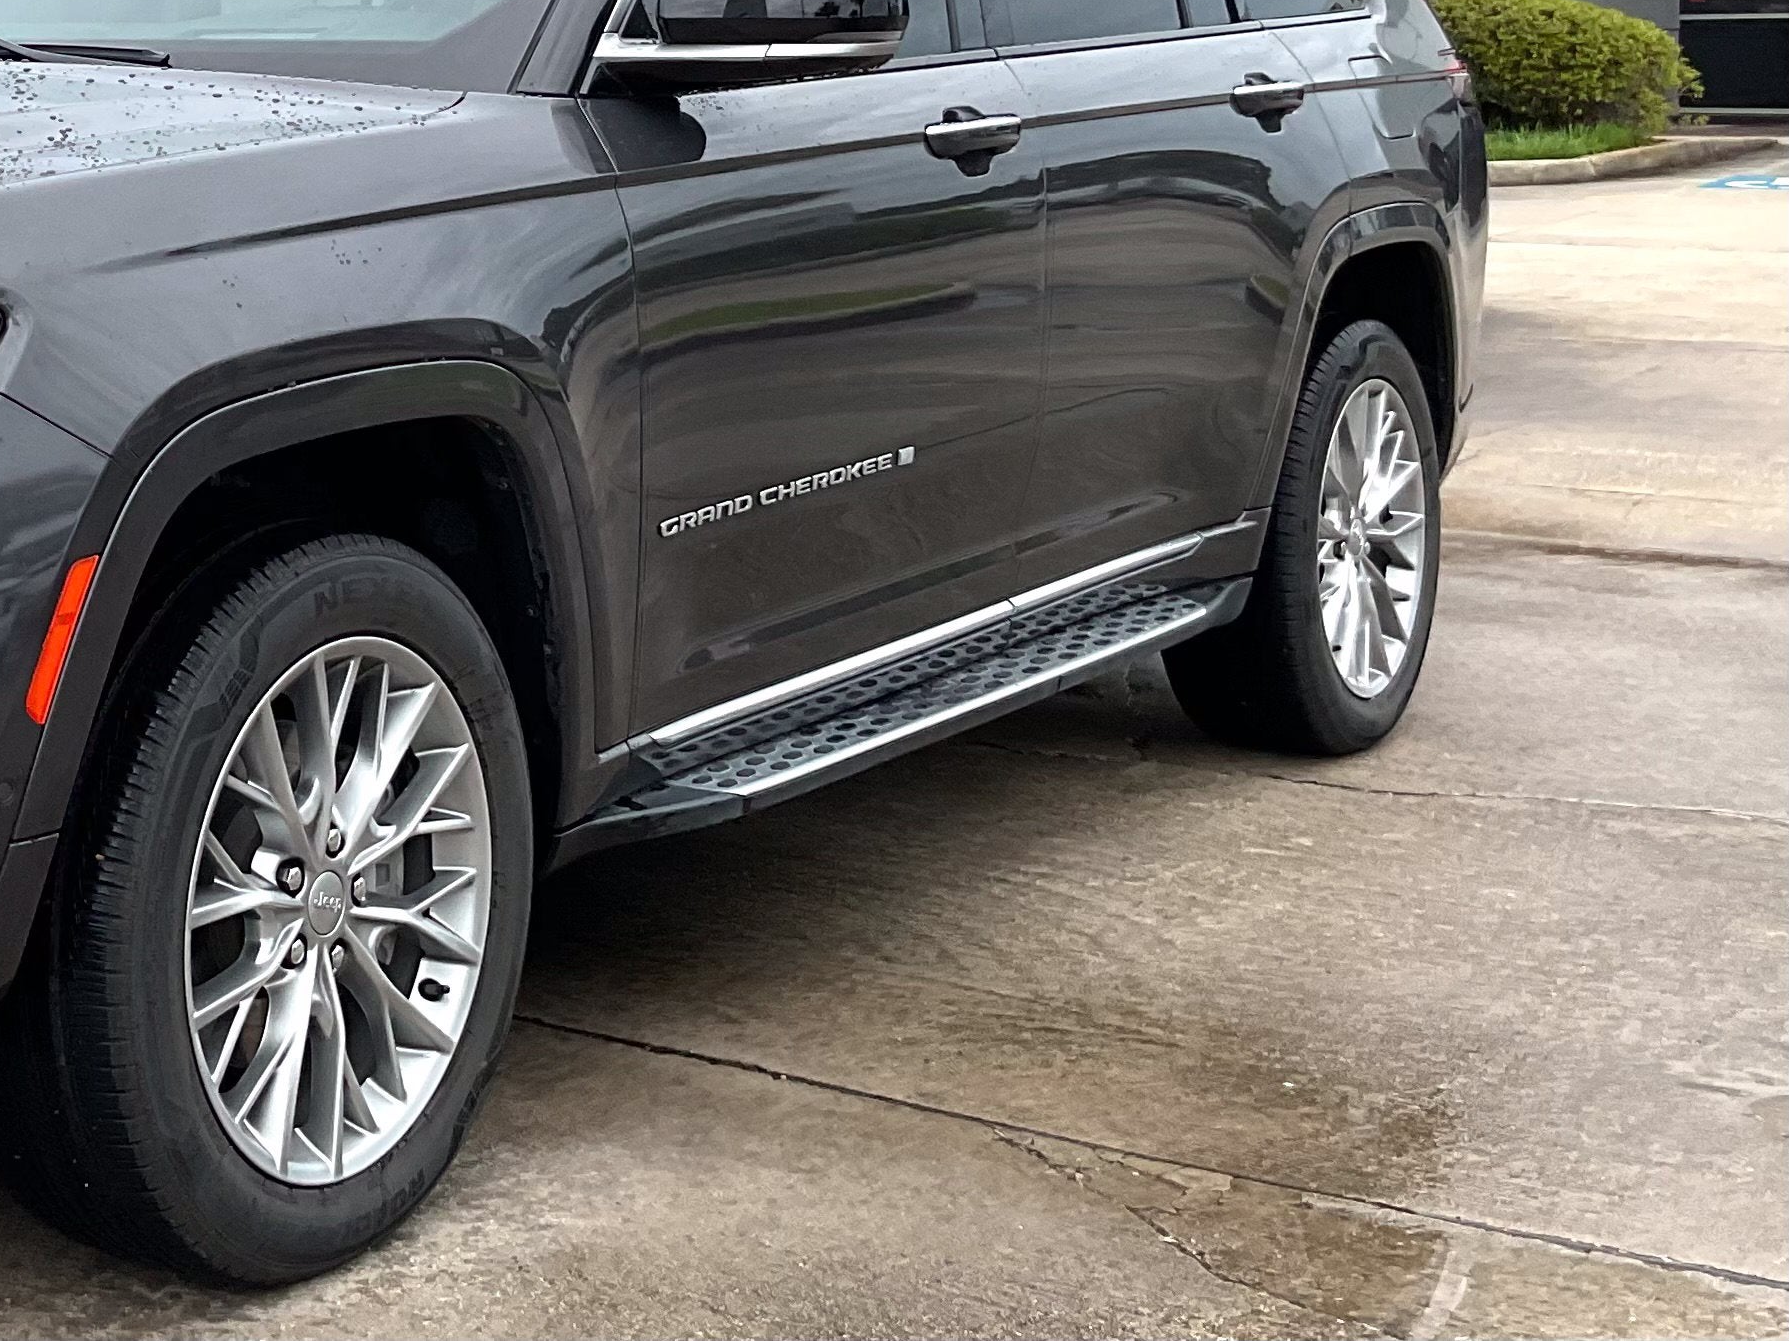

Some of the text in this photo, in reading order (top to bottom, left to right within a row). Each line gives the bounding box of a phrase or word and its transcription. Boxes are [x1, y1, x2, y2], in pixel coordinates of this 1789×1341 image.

[659, 494, 753, 538] GRAND
[759, 452, 894, 507] CHEROKEE
[313, 891, 342, 913] Jeep
